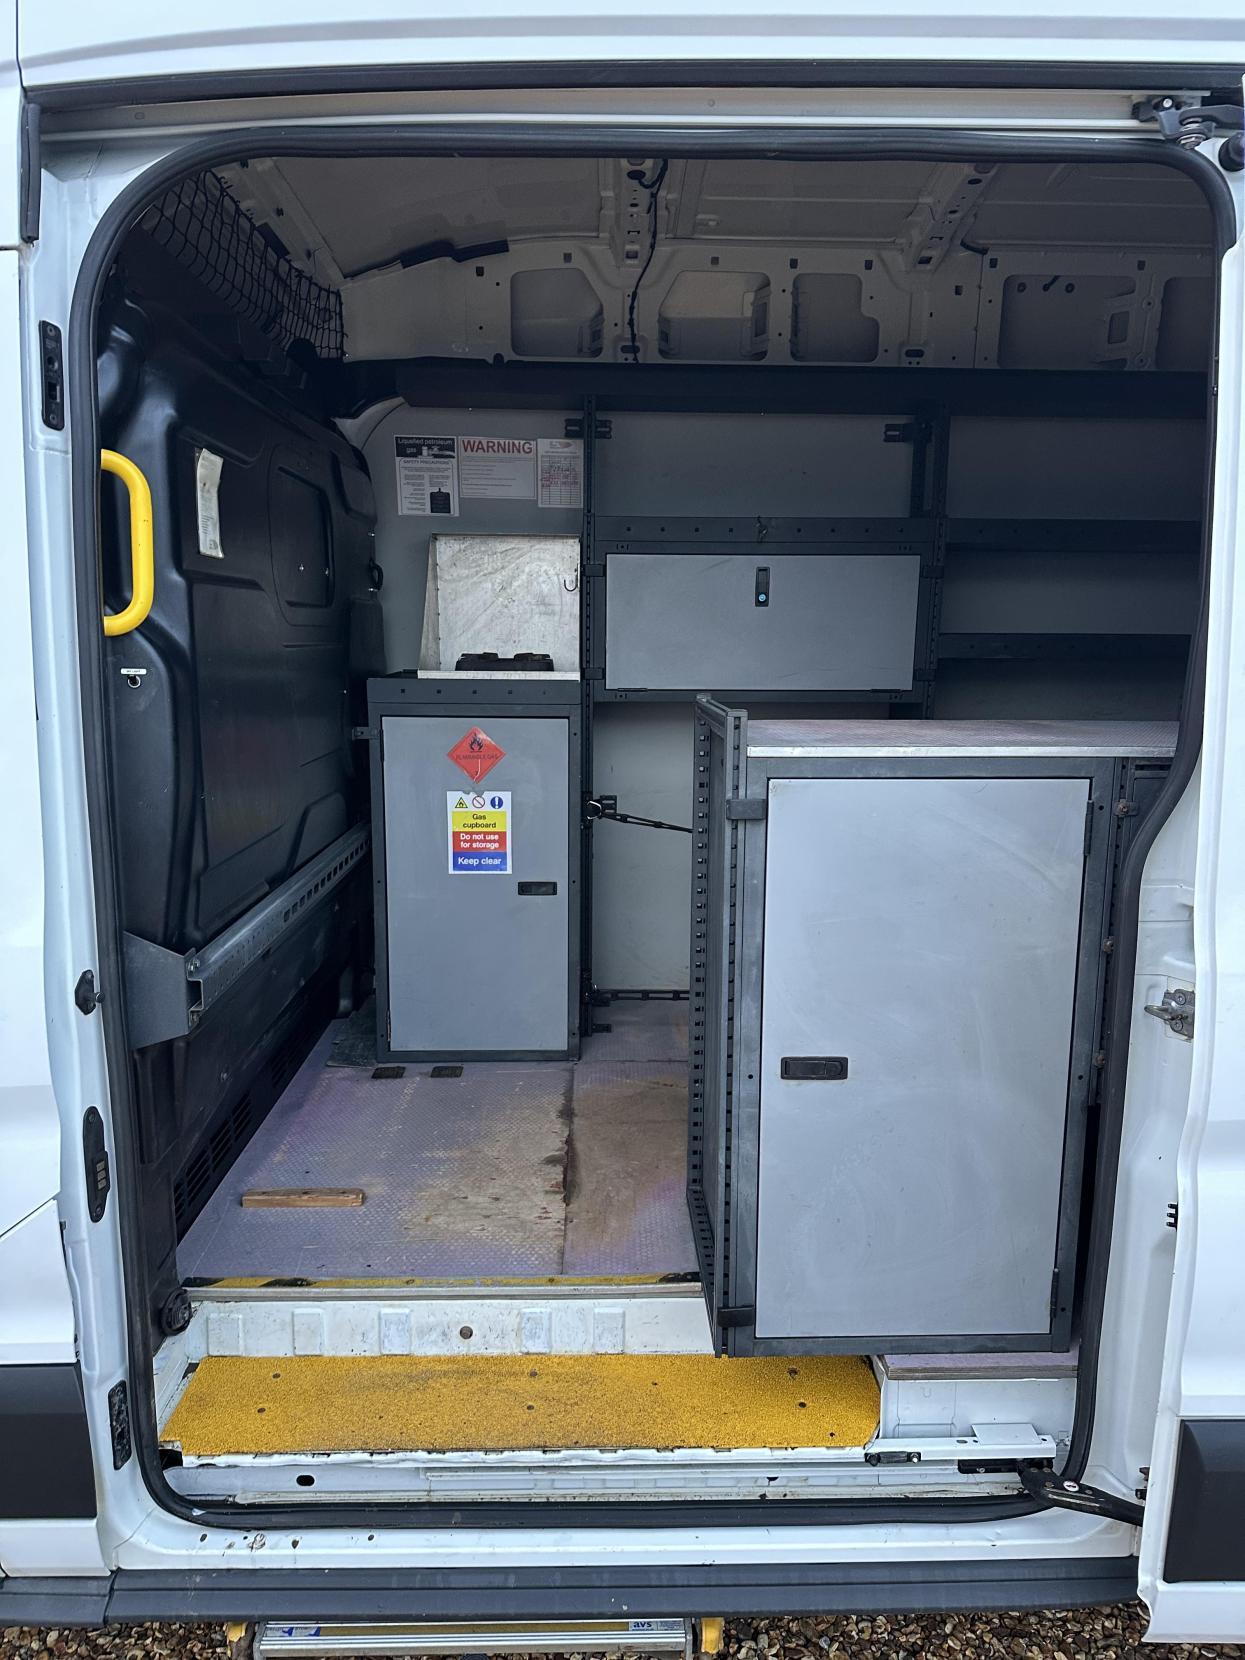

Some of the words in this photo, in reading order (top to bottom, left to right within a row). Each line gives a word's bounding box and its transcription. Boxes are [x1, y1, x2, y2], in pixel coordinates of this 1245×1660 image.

[424, 438, 453, 446] petroleum
[462, 439, 533, 454] WARNING
[458, 857, 479, 866] Keep
[481, 856, 502, 864] clear
